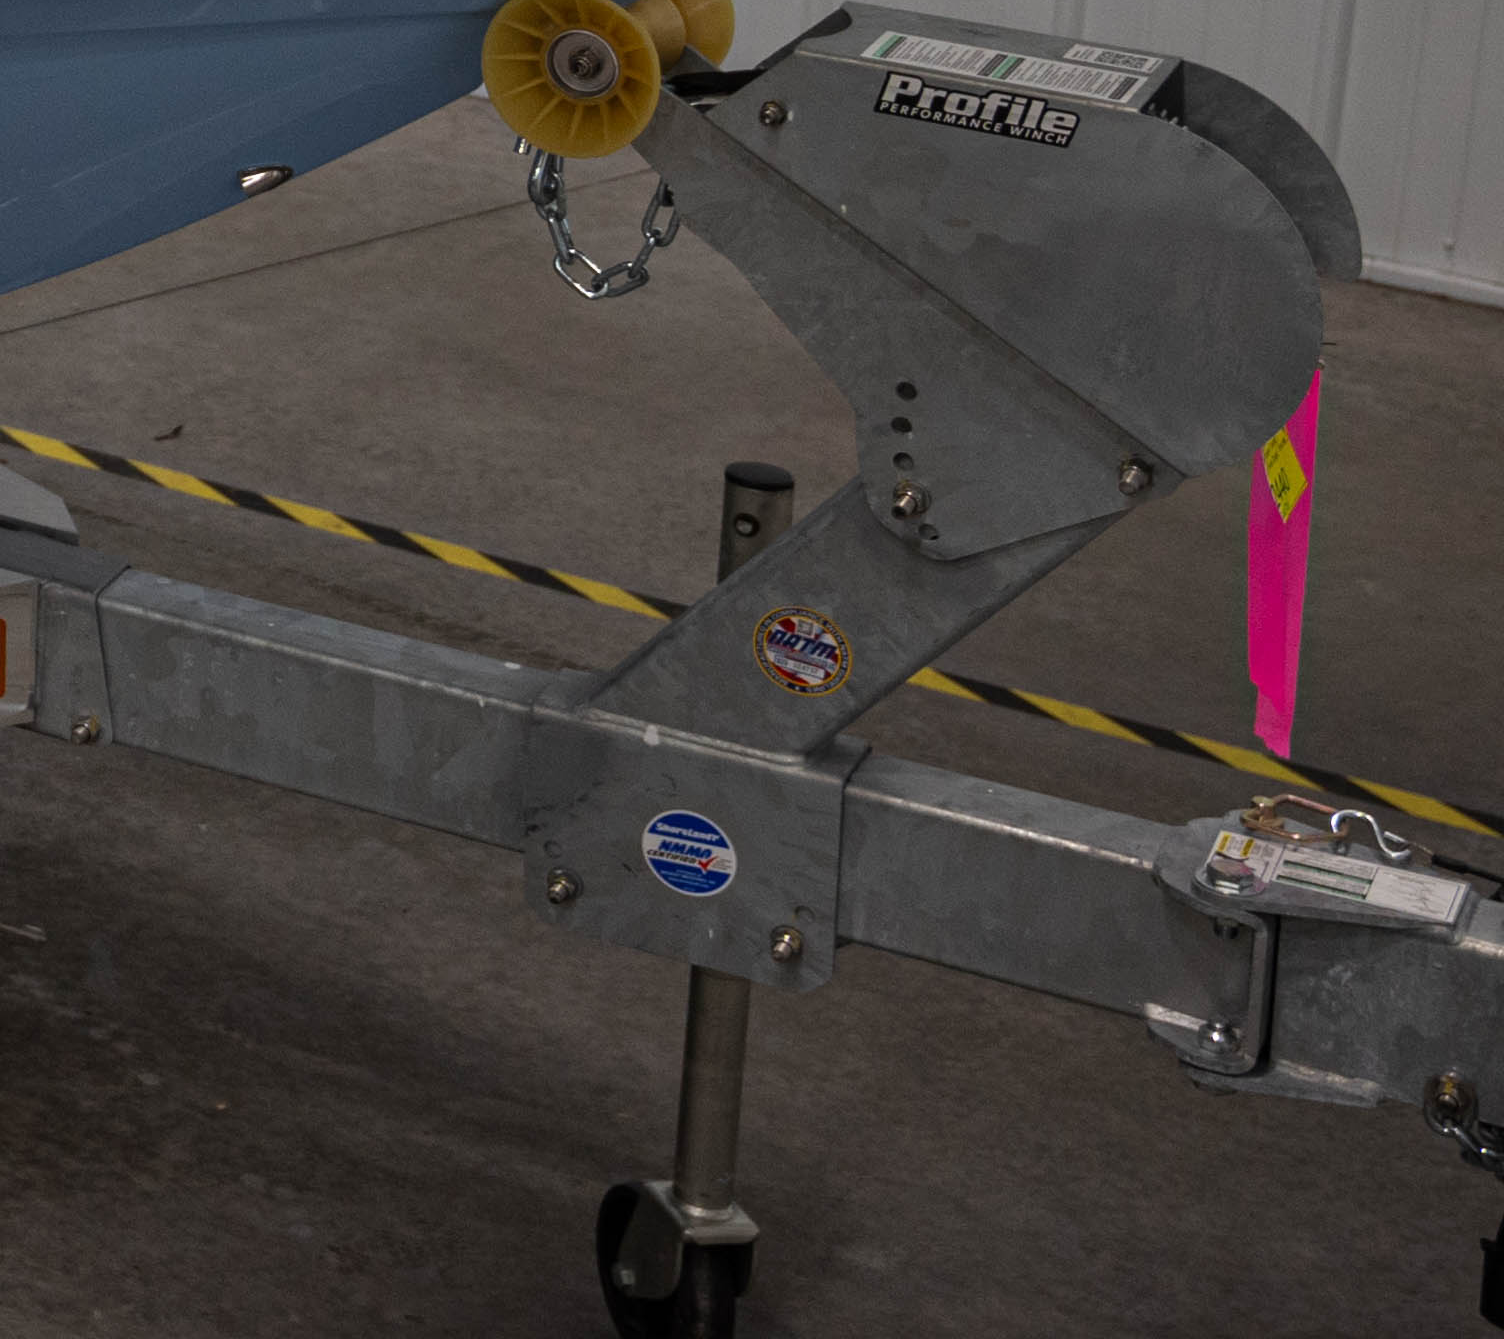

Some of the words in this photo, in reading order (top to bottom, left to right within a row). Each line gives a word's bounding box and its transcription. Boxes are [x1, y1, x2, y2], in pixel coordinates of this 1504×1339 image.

[879, 102, 1002, 133] PERFORMANCE
[1009, 125, 1068, 145] WINCH
[881, 74, 1078, 135] Profile
